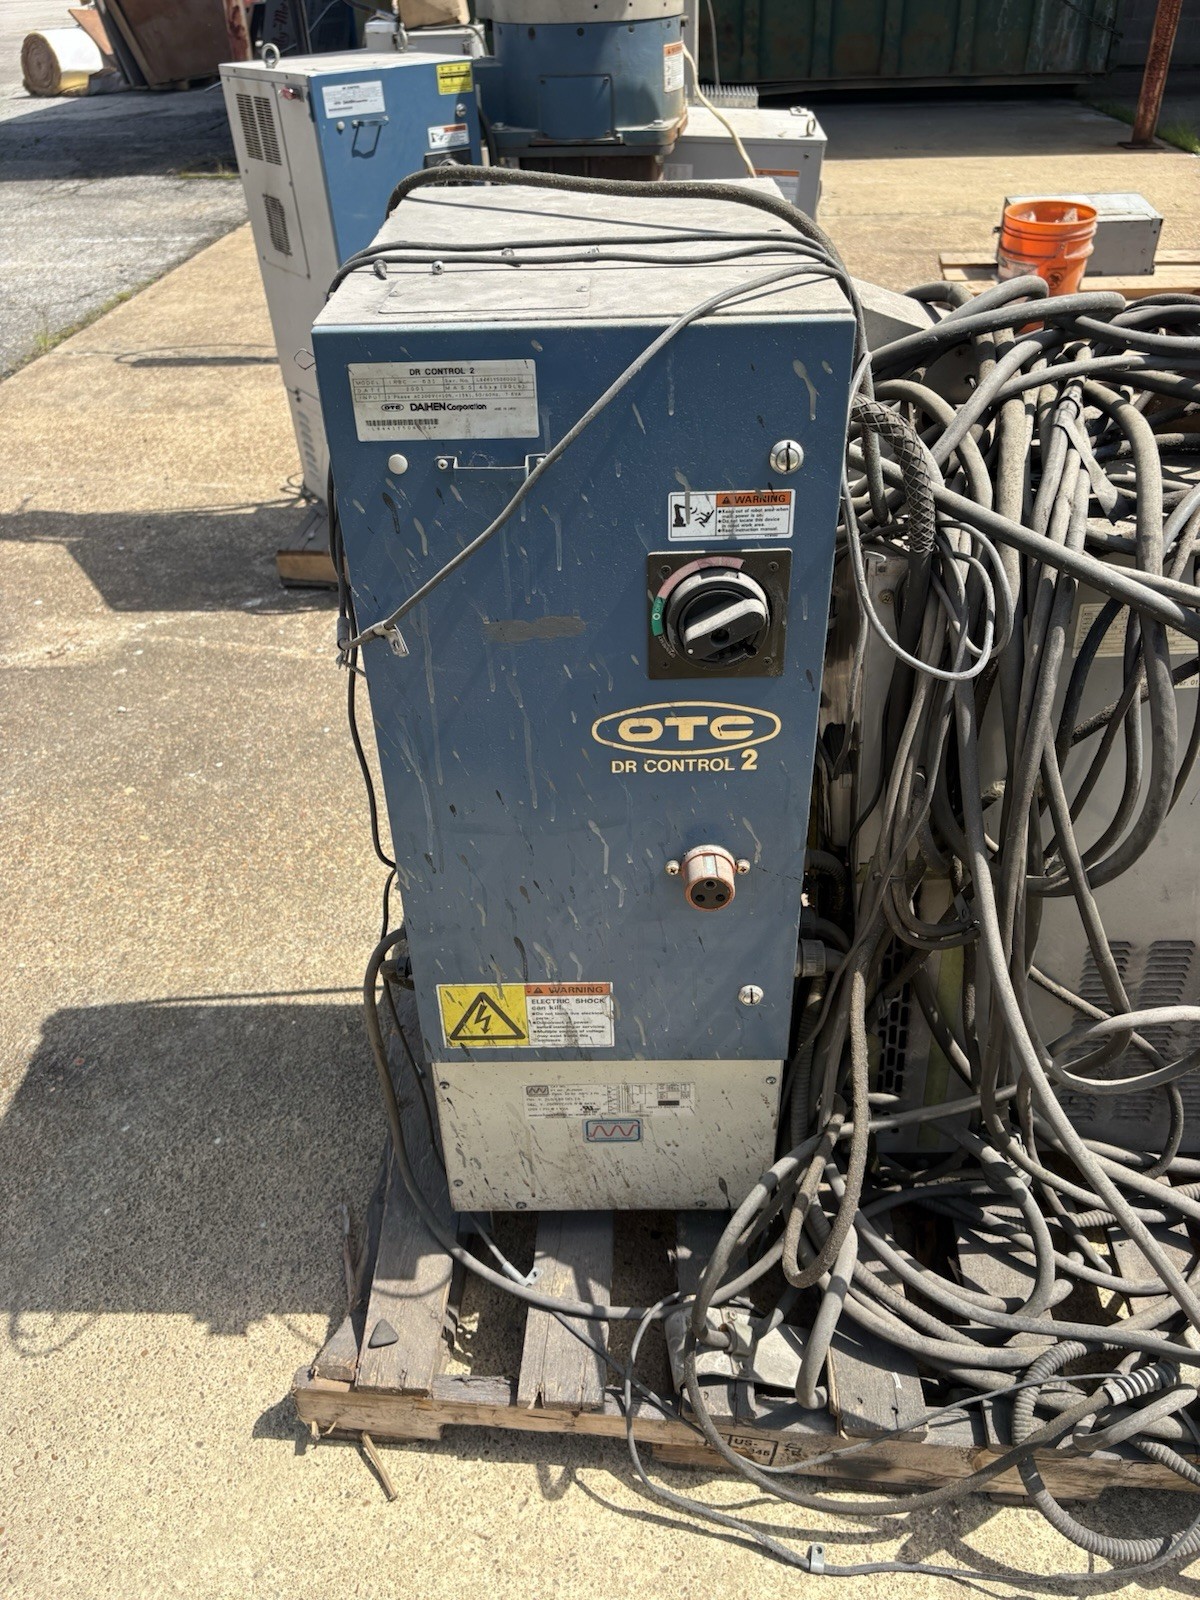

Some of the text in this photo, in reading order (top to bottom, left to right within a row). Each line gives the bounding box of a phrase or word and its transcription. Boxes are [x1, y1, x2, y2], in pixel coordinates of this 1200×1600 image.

[410, 403, 446, 411] DAIHEN
[447, 403, 487, 411] Corporation
[734, 495, 786, 504] WARNING
[618, 716, 754, 742] OTC
[612, 749, 758, 773] DR CONTROL 2
